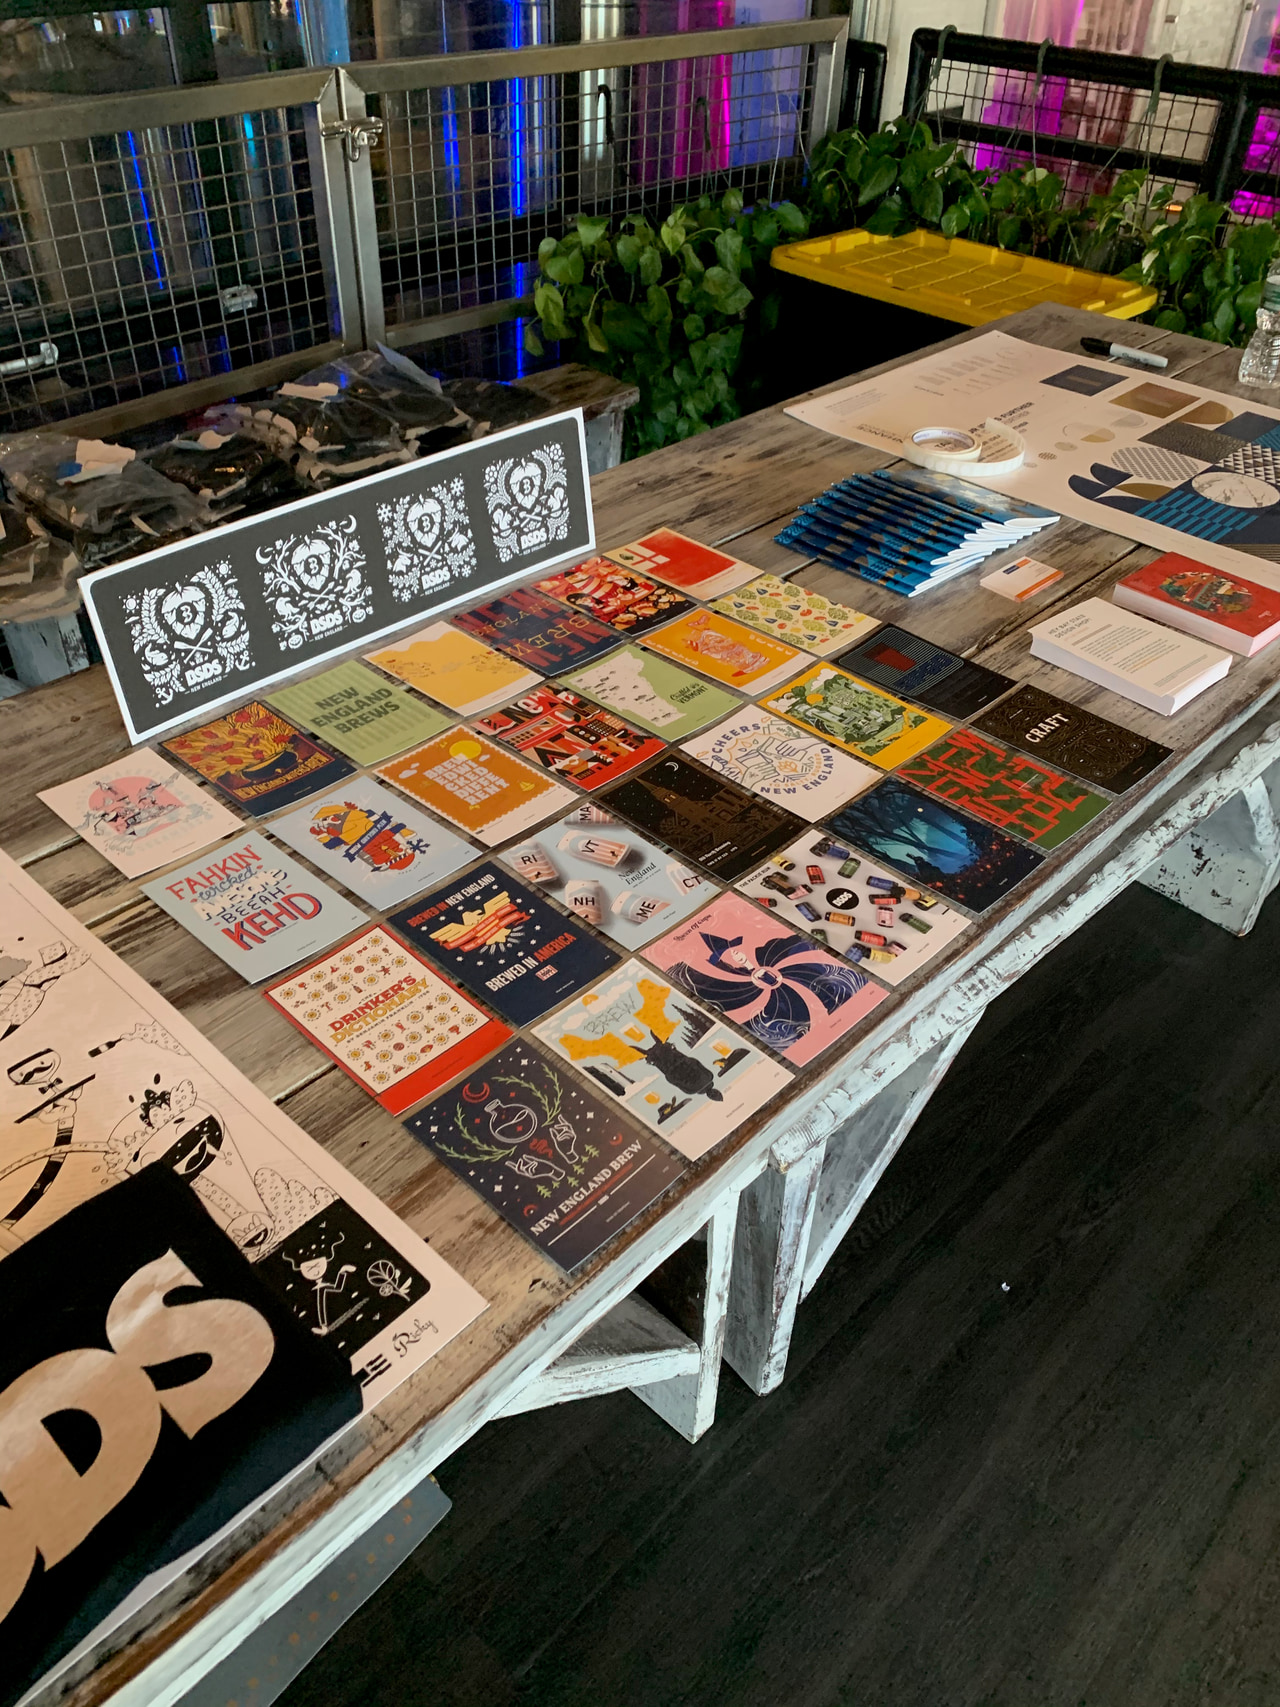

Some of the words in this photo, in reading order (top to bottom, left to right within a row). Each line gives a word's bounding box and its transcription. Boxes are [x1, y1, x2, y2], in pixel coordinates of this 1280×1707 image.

[520, 528, 548, 550] DSDS
[421, 568, 451, 590] DSDS
[310, 610, 344, 635] DSDS
[314, 633, 323, 641] NEW
[322, 626, 343, 639] ENGLAND
[506, 616, 590, 657] BREW
[184, 659, 223, 687] DSDS
[190, 684, 201, 693] NEW
[201, 675, 222, 690] ENGLAND
[310, 688, 393, 728] ENGLAND
[314, 687, 360, 710] NEW
[677, 685, 709, 704] VERMONT
[334, 701, 401, 734] BREWS
[1025, 712, 1070, 744] CRAFT
[711, 723, 761, 754] CHEERS
[232, 784, 257, 799] NEW
[254, 775, 284, 794] ENGLAND
[306, 751, 330, 772] BREW
[422, 752, 468, 780] BREW
[760, 786, 797, 795] NEW
[802, 747, 835, 791] ENGLAND
[580, 805, 592, 822] MA
[521, 854, 538, 866] RI
[581, 839, 600, 855] VT
[165, 844, 263, 900] FAHKIN'
[198, 864, 257, 901] wicked
[618, 867, 636, 881] New
[624, 862, 657, 886] England
[682, 875, 702, 889] CT
[739, 880, 749, 888] THE
[221, 886, 286, 924] BEEAH
[406, 907, 439, 928] BREWED
[438, 900, 450, 914] IN
[444, 891, 464, 908] NEW
[461, 873, 496, 898] ENGLAND
[574, 897, 595, 906] NH
[636, 900, 656, 919] ME
[832, 890, 853, 907] DSDS
[221, 892, 323, 951] KEHD
[485, 964, 528, 993] BREWED
[523, 956, 539, 973] IN
[533, 932, 577, 963] AMERICA
[328, 974, 418, 1033] DRINKER'S
[329, 977, 430, 1044] DICTIONARY
[583, 991, 637, 1036] BREW
[346, 1035, 355, 1044] BY
[355, 1019, 384, 1038] BENJAMIN
[383, 1000, 414, 1021] FRANKLIN
[530, 1208, 561, 1237] NEW
[558, 1168, 612, 1213] ENGLAND
[610, 1139, 643, 1173] BREW
